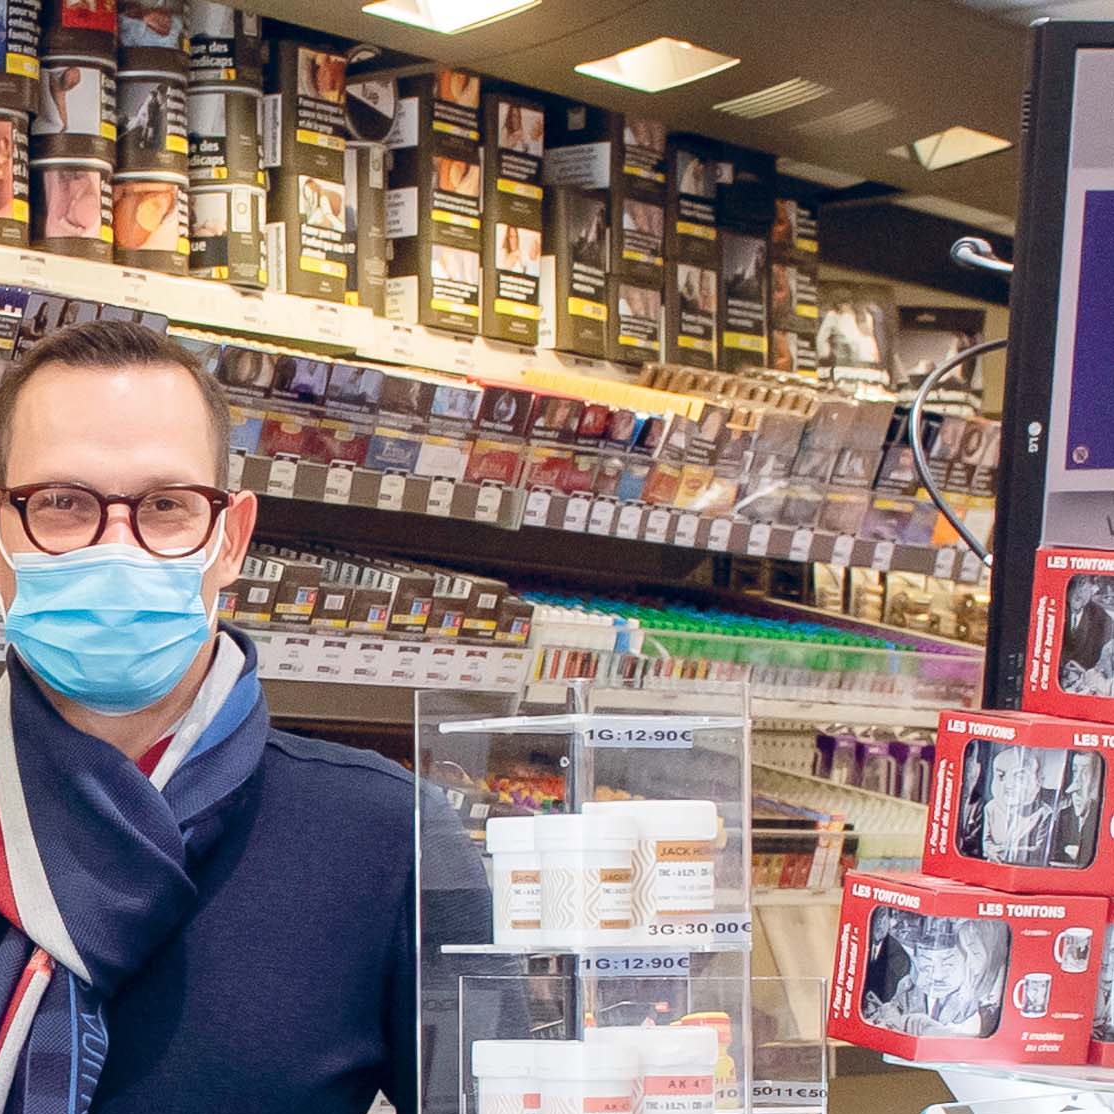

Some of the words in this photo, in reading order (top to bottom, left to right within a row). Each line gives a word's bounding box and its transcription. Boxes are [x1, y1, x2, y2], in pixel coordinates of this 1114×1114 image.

[1047, 556, 1068, 569] LES
[1070, 557, 1114, 571] TONTON
[947, 719, 967, 733] LES
[968, 721, 1016, 740] TONTONS
[1073, 733, 1099, 747] LES
[660, 847, 690, 857] JACK
[852, 884, 871, 898] LES
[873, 888, 921, 908] TONTONS
[978, 903, 1003, 916] LES
[1007, 903, 1066, 918] TONTONS
